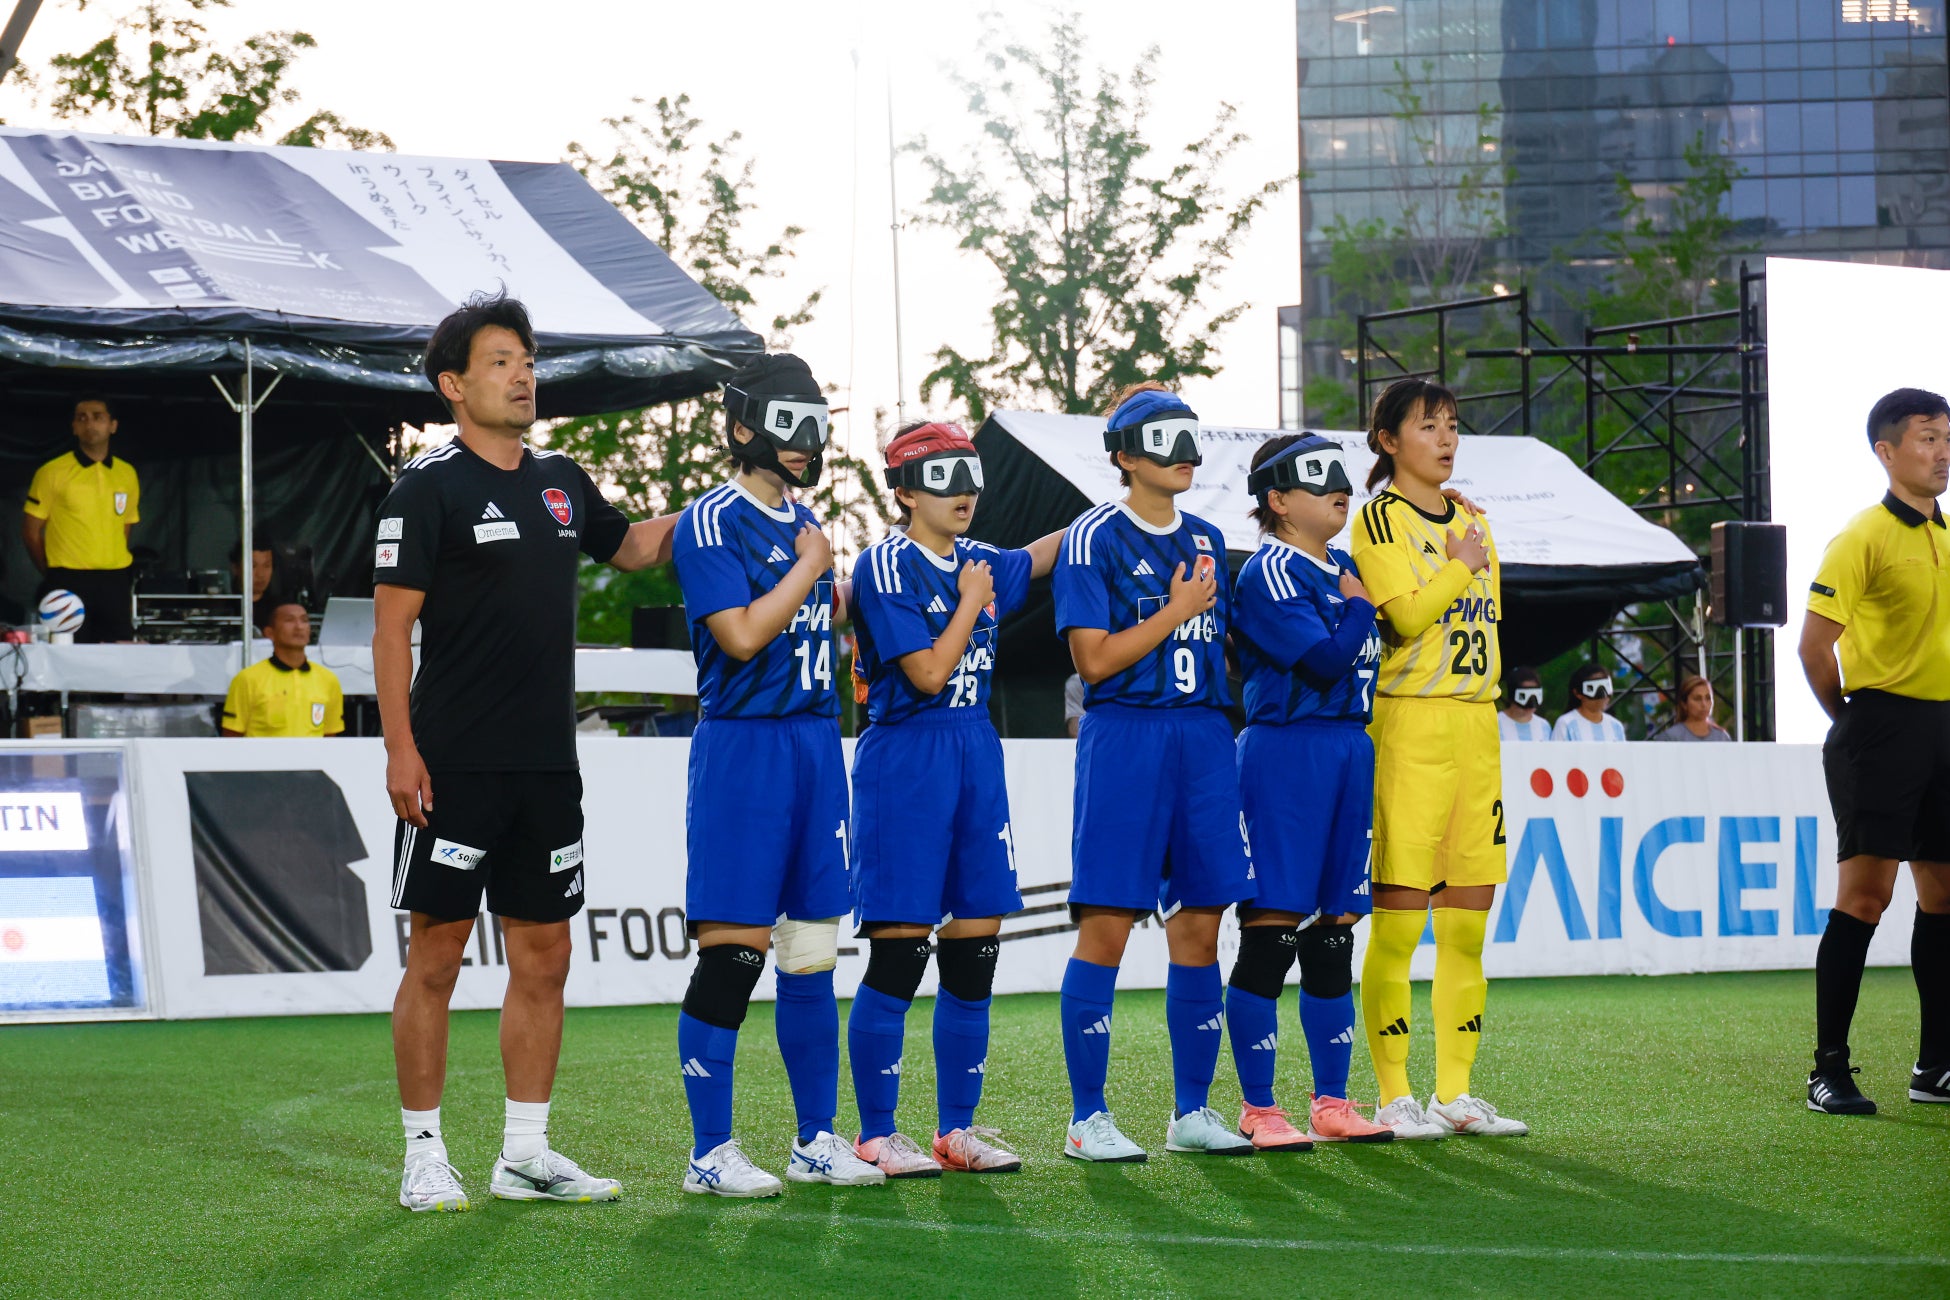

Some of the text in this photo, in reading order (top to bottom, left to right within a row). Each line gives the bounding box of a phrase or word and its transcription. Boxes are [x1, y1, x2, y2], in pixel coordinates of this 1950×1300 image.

[1434, 598, 1497, 624] PMG
[794, 639, 832, 691] 14
[1173, 647, 1197, 694] 9
[1450, 629, 1488, 676] 23
[1357, 669, 1375, 713] 7
[997, 822, 1016, 871] 1
[1493, 817, 1830, 943] AICEL
